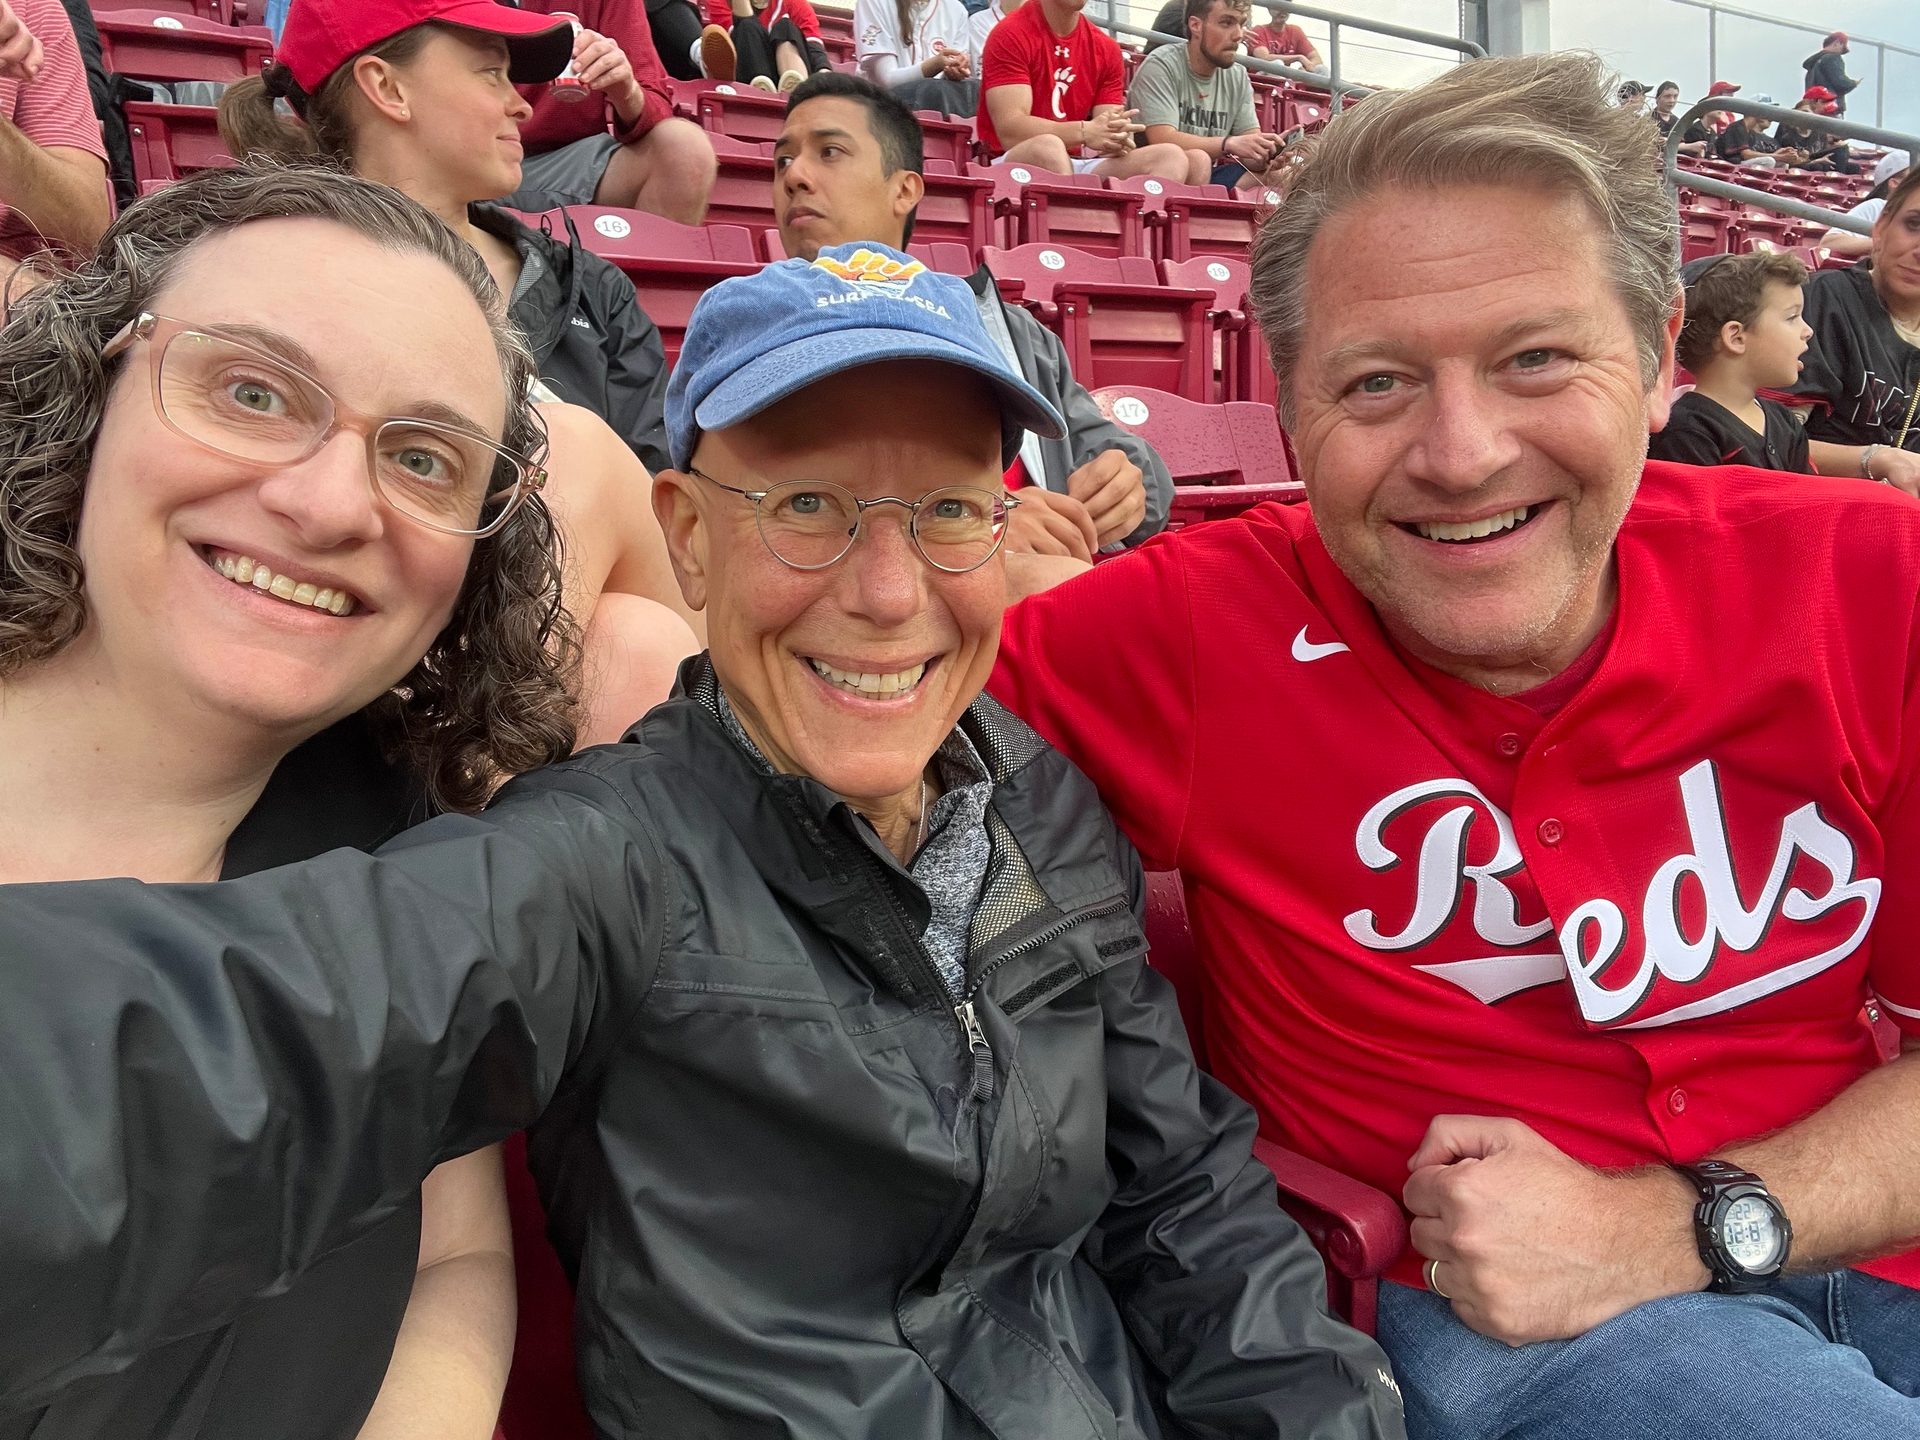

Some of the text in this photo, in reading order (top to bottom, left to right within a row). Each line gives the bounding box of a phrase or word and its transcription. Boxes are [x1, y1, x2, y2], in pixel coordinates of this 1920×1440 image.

[602, 220, 622, 233] 16
[1044, 254, 1060, 266] 18
[1120, 402, 1139, 418] 17
[1343, 758, 1882, 1030] Reds
